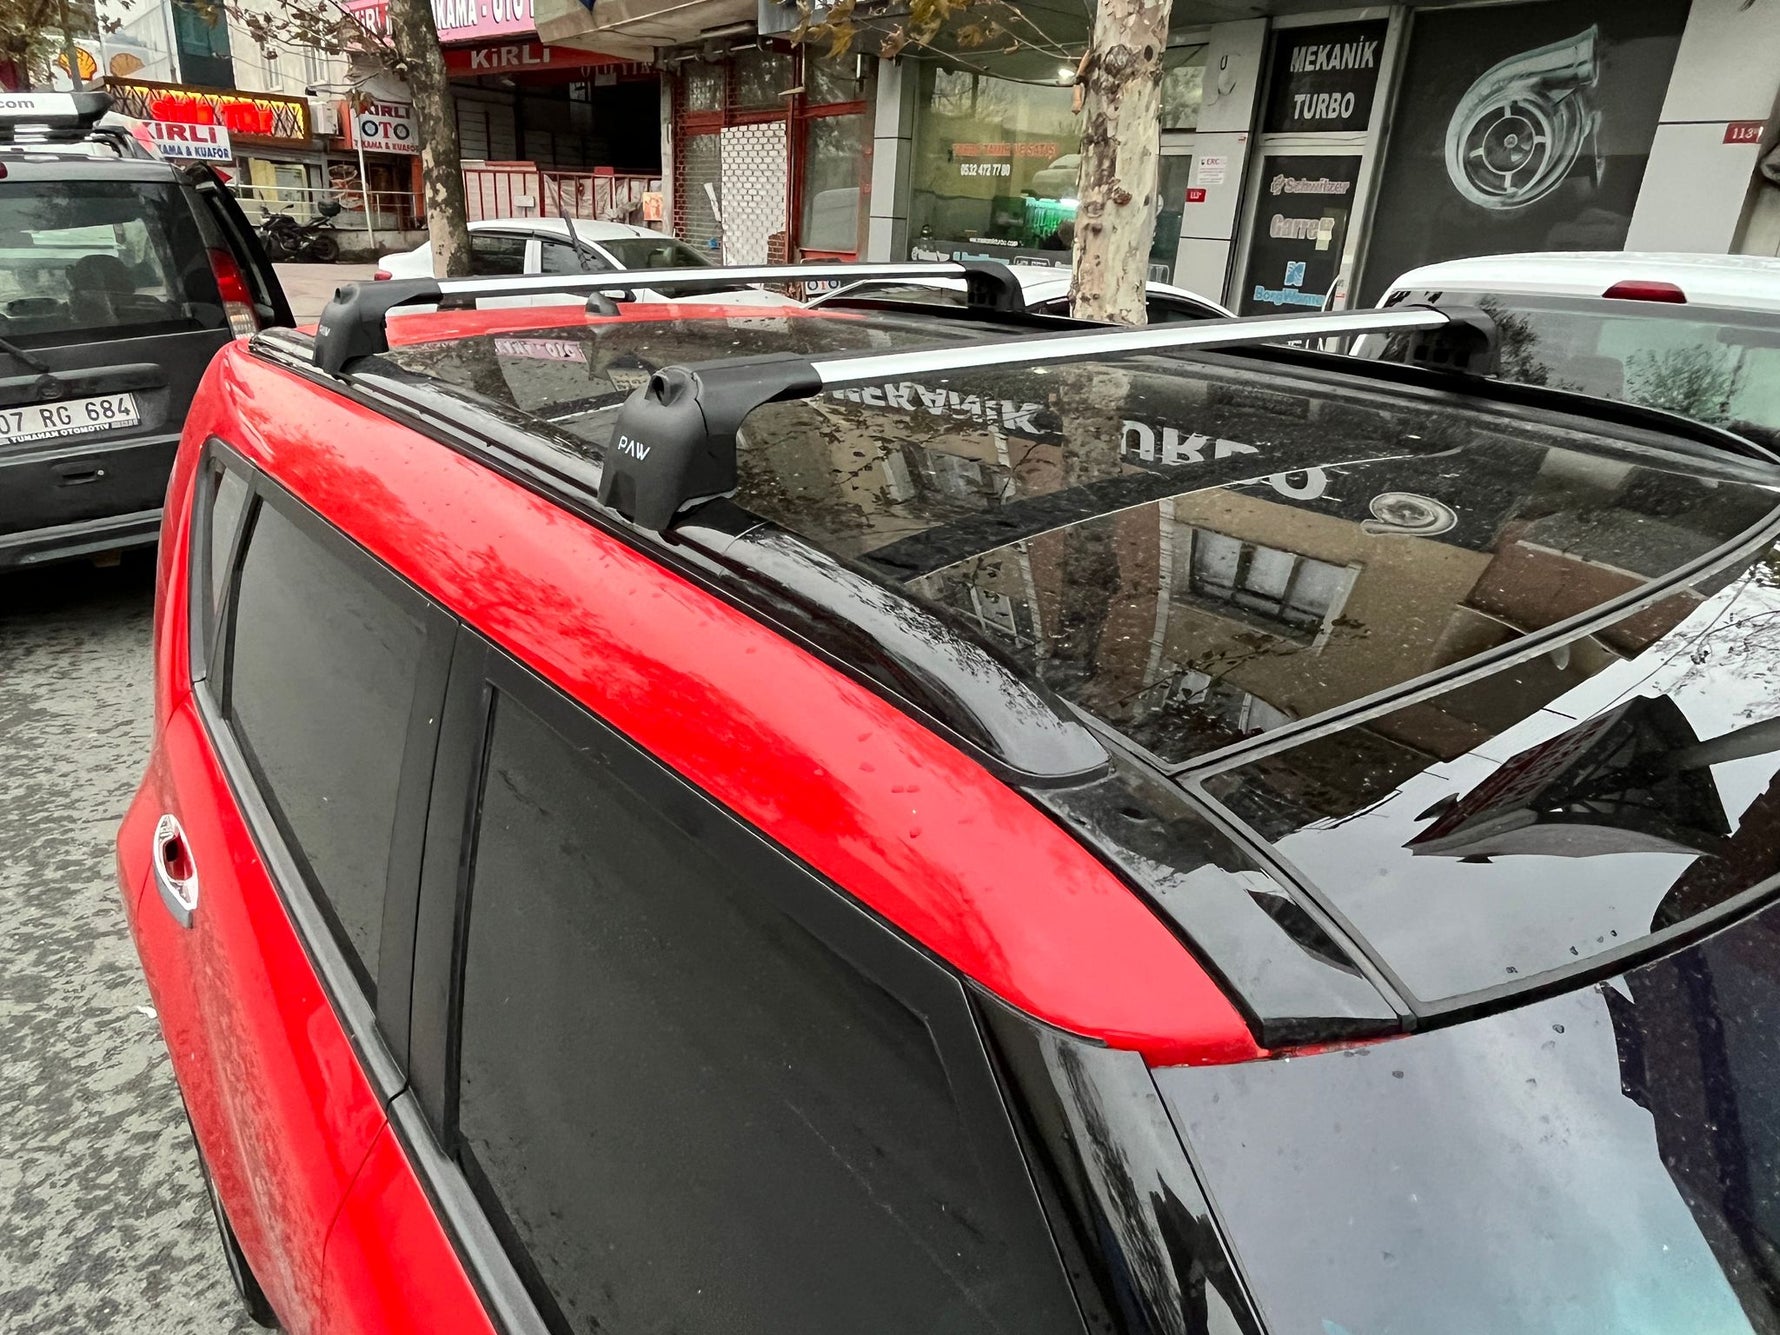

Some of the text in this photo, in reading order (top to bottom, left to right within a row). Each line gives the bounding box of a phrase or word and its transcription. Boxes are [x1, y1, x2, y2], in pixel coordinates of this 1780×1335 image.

[1290, 35, 1378, 72] MEKANİK
[1294, 92, 1355, 120] TURBO
[361, 120, 410, 140] OTO
[960, 164, 977, 176] 0532
[978, 164, 991, 176] 472
[992, 164, 1001, 176] 77
[39, 406, 71, 428] RG
[85, 398, 131, 421] 684
[618, 435, 651, 460] PAW
